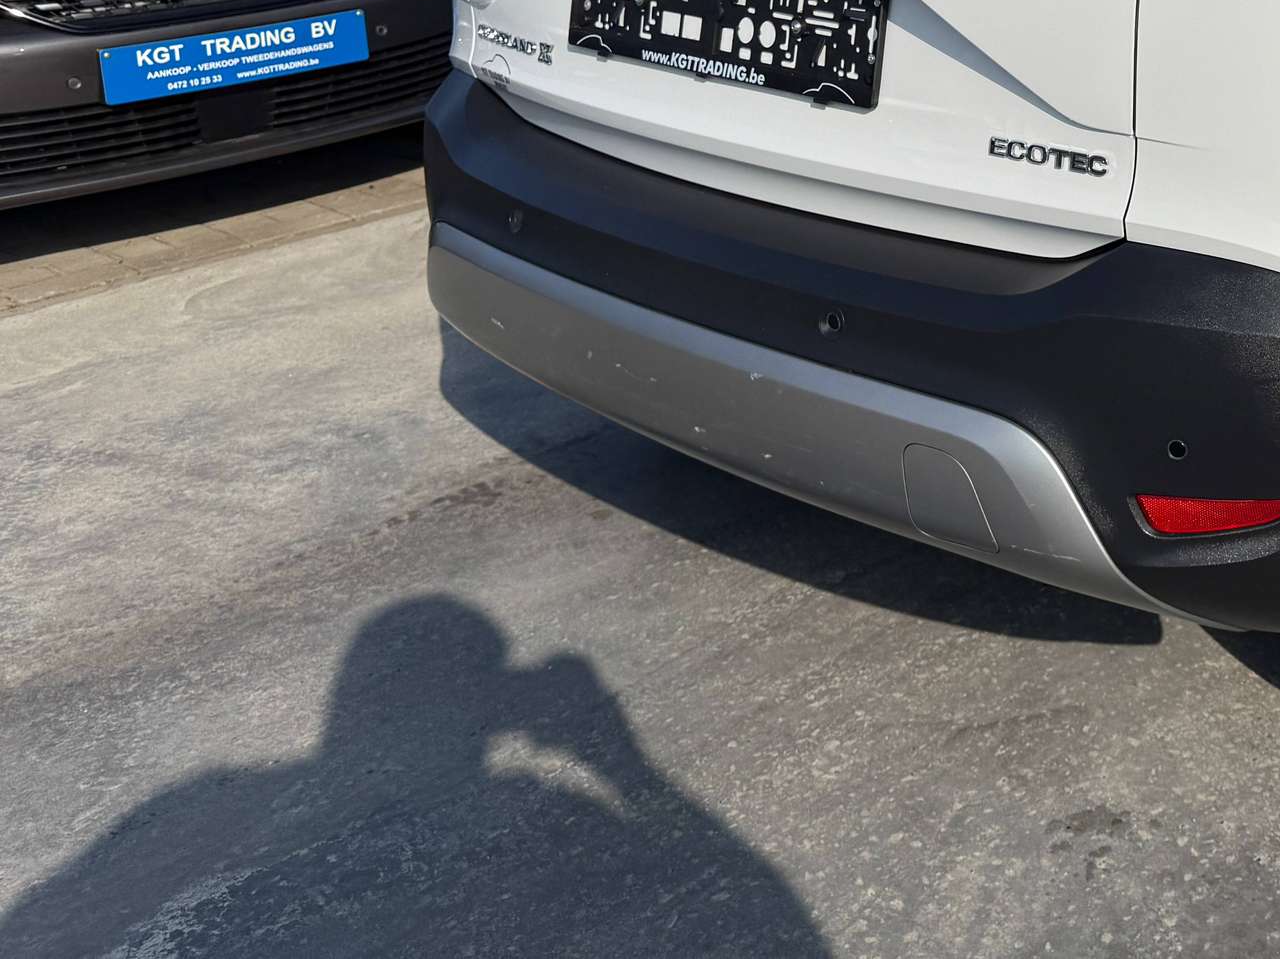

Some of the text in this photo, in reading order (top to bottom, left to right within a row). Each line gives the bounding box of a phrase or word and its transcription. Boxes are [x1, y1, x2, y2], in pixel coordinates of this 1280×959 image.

[136, 19, 337, 67] KGT TRADING BV
[146, 65, 192, 81] AANKOOP
[198, 57, 240, 72] VERKOOP
[241, 41, 335, 64] TWEEDEHANDSWAGENS
[167, 80, 188, 91] 0472
[190, 78, 200, 88] 10
[212, 74, 222, 84] 33
[236, 57, 320, 79] www.KGTTRADING.be
[641, 49, 766, 86] www.KGTTRADING.be
[989, 136, 1109, 177] ECOTEC
